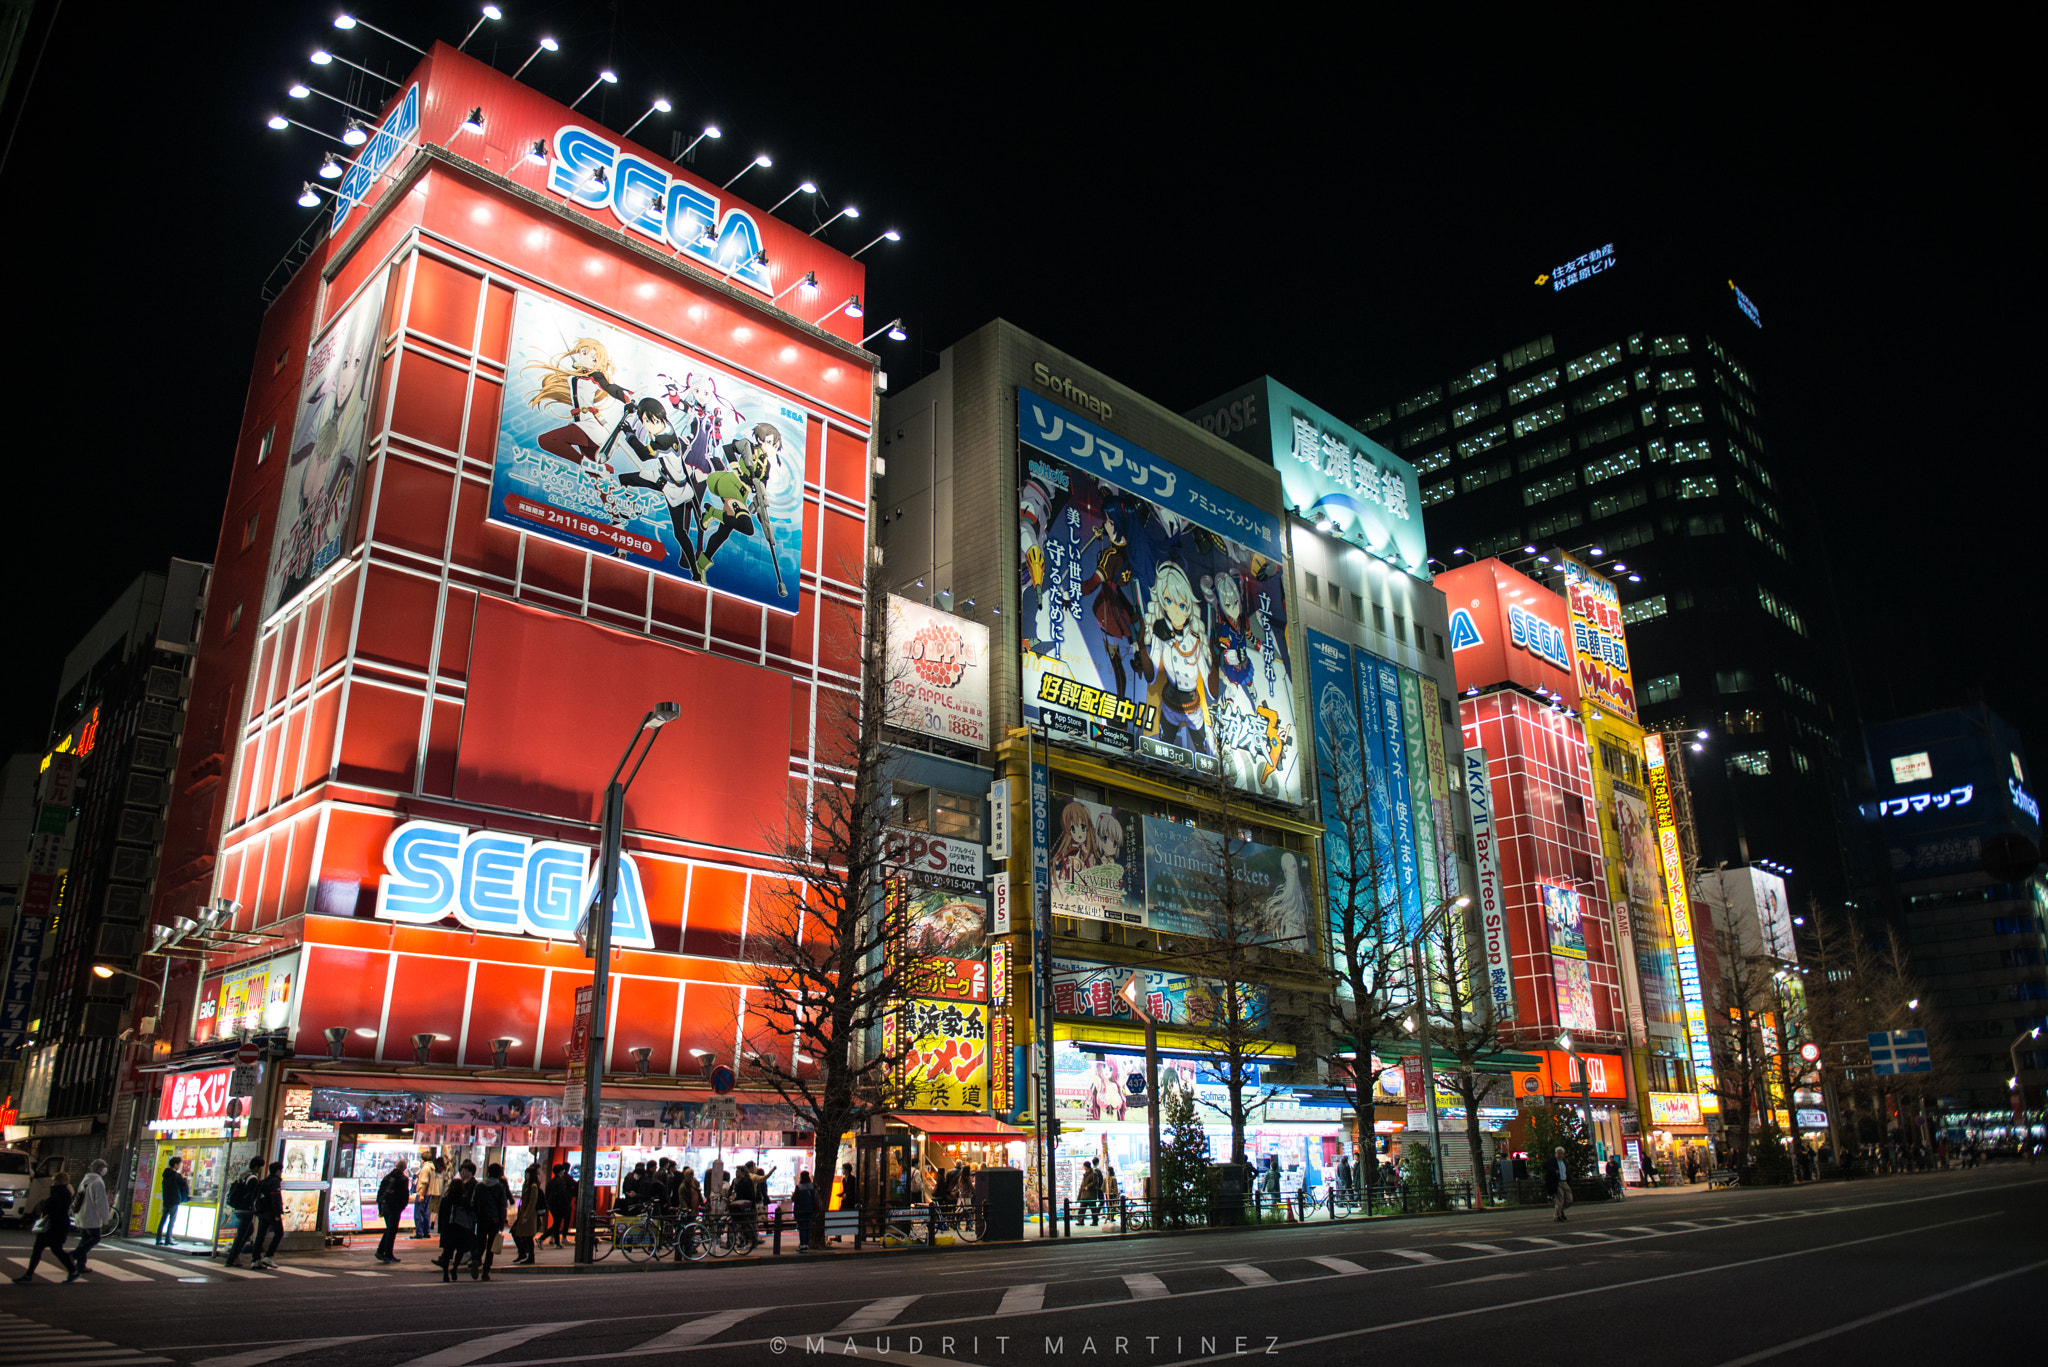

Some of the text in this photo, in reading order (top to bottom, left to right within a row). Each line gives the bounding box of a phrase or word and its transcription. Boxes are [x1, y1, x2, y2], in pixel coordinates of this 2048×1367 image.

[331, 82, 420, 238] SEGA
[547, 125, 775, 297] SEGA
[1552, 243, 1615, 279] 住友不動産
[1553, 257, 1616, 292] 秋葉原ビル
[1033, 361, 1113, 422] Sofmap
[780, 407, 804, 424] SEGA
[512, 446, 667, 511] ソードアート・オンライン
[1029, 459, 1070, 487] miHoYo
[1032, 404, 1272, 544] ソフマップ アミューズメント館
[531, 470, 649, 515] SWORD ART ONLINE
[543, 483, 642, 519] オーディナル・スケール
[312, 534, 341, 578] SEGA
[1067, 507, 1083, 620] 美しい世界を
[1046, 540, 1066, 659] 守るために！
[1568, 584, 1623, 640] 激安販売
[924, 640, 978, 667] APPLE
[1258, 592, 1277, 697] 立ち上がれ！
[1508, 603, 1571, 672] SEGA
[1574, 621, 1629, 672] 高額買取
[894, 680, 916, 698] BIG
[1578, 659, 1637, 714] Mulan
[1054, 713, 1082, 727] App Store
[1650, 767, 1665, 775] DVD
[1033, 783, 1047, 844] 売るのも
[884, 832, 948, 870] GPS
[950, 845, 976, 855] リアルタイム
[1154, 843, 1214, 874] Summer
[375, 820, 656, 949] SEGA
[950, 862, 976, 876] next
[1069, 857, 1122, 890] Rewrite
[1661, 831, 1690, 938] お売り下さい
[997, 884, 1006, 921] GPS
[1085, 894, 1120, 906] Memoria
[1476, 827, 1495, 911] Tax-free
[1486, 914, 1502, 965] Shop
[1616, 906, 1630, 937] GAME
[1, 916, 43, 1048] ホビーステーション
[972, 963, 986, 998] 2F
[993, 951, 1005, 996] ラーメン
[1113, 967, 1164, 985] ソフップ
[199, 998, 216, 1020] BIG
[993, 996, 1005, 1006] 1F
[1803, 1048, 1816, 1056] 50
[1128, 1078, 1144, 1088] 437
[1587, 1057, 1608, 1093] SEGA
[183, 1073, 226, 1117] 宝くじ
[1200, 1091, 1227, 1102] Sofmap
